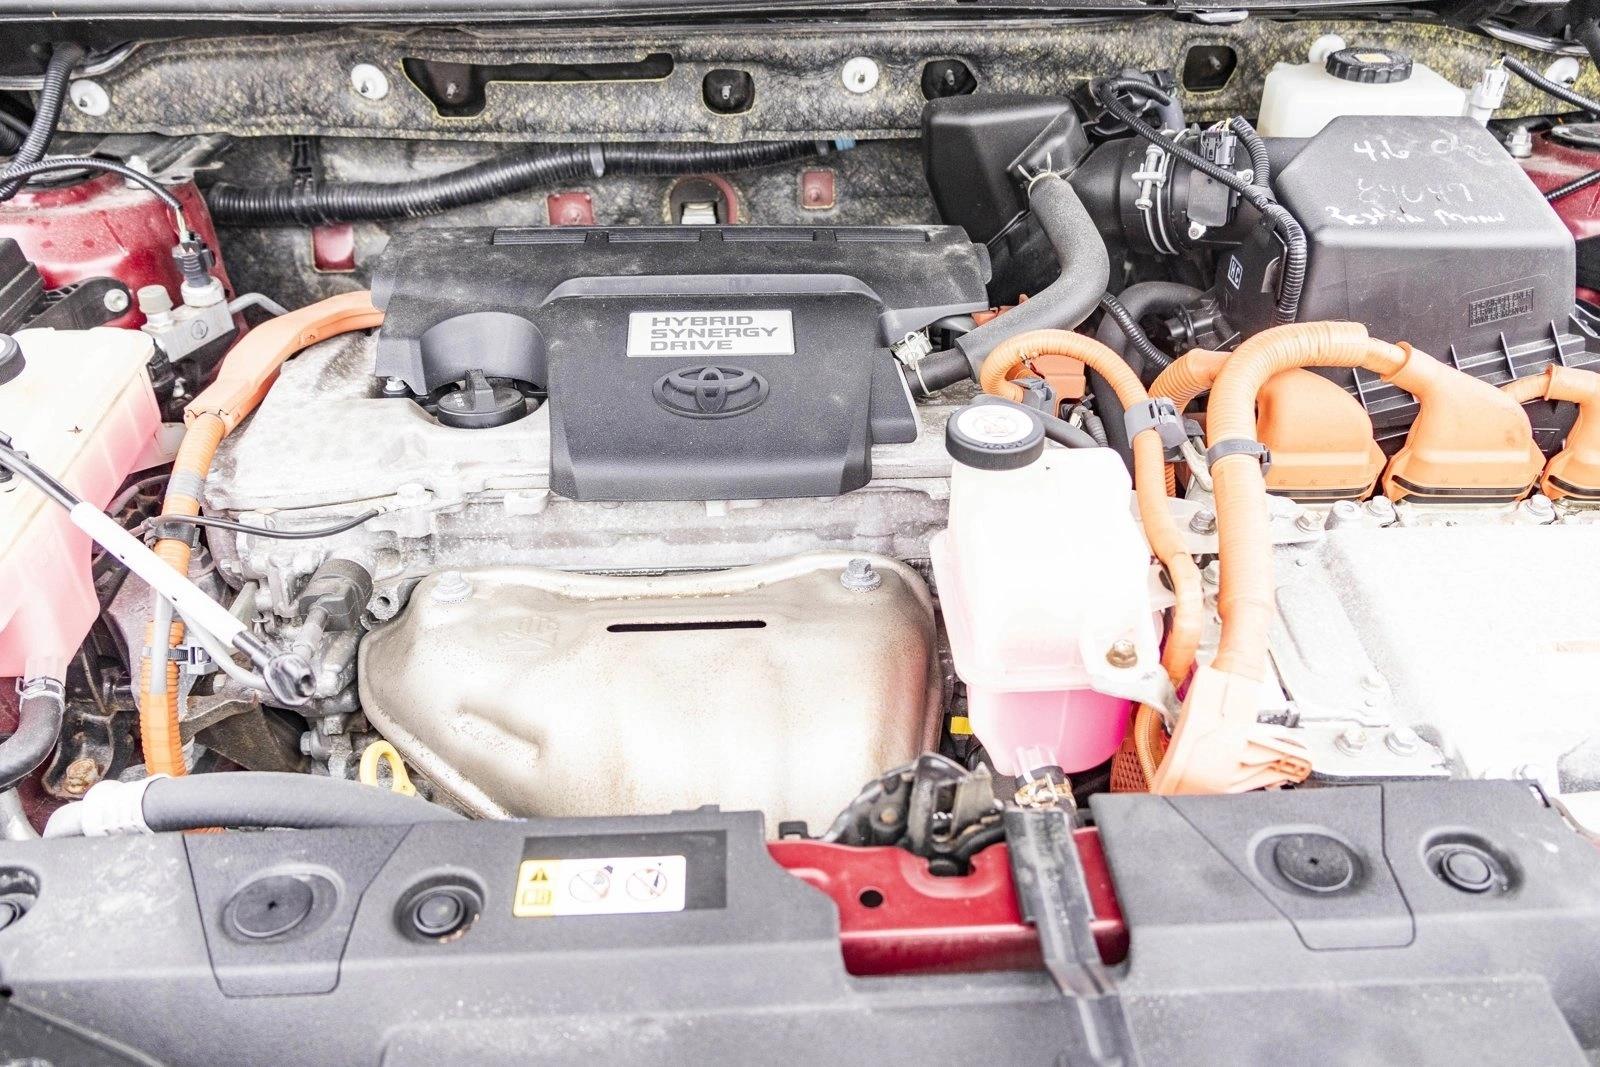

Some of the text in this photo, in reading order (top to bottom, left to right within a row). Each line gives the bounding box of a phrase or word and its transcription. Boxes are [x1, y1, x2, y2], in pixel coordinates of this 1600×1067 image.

[1230, 260, 1241, 284] HC
[652, 315, 754, 327] HYBRID
[651, 327, 778, 340] SYNERGY
[651, 340, 733, 351] DRIVE
